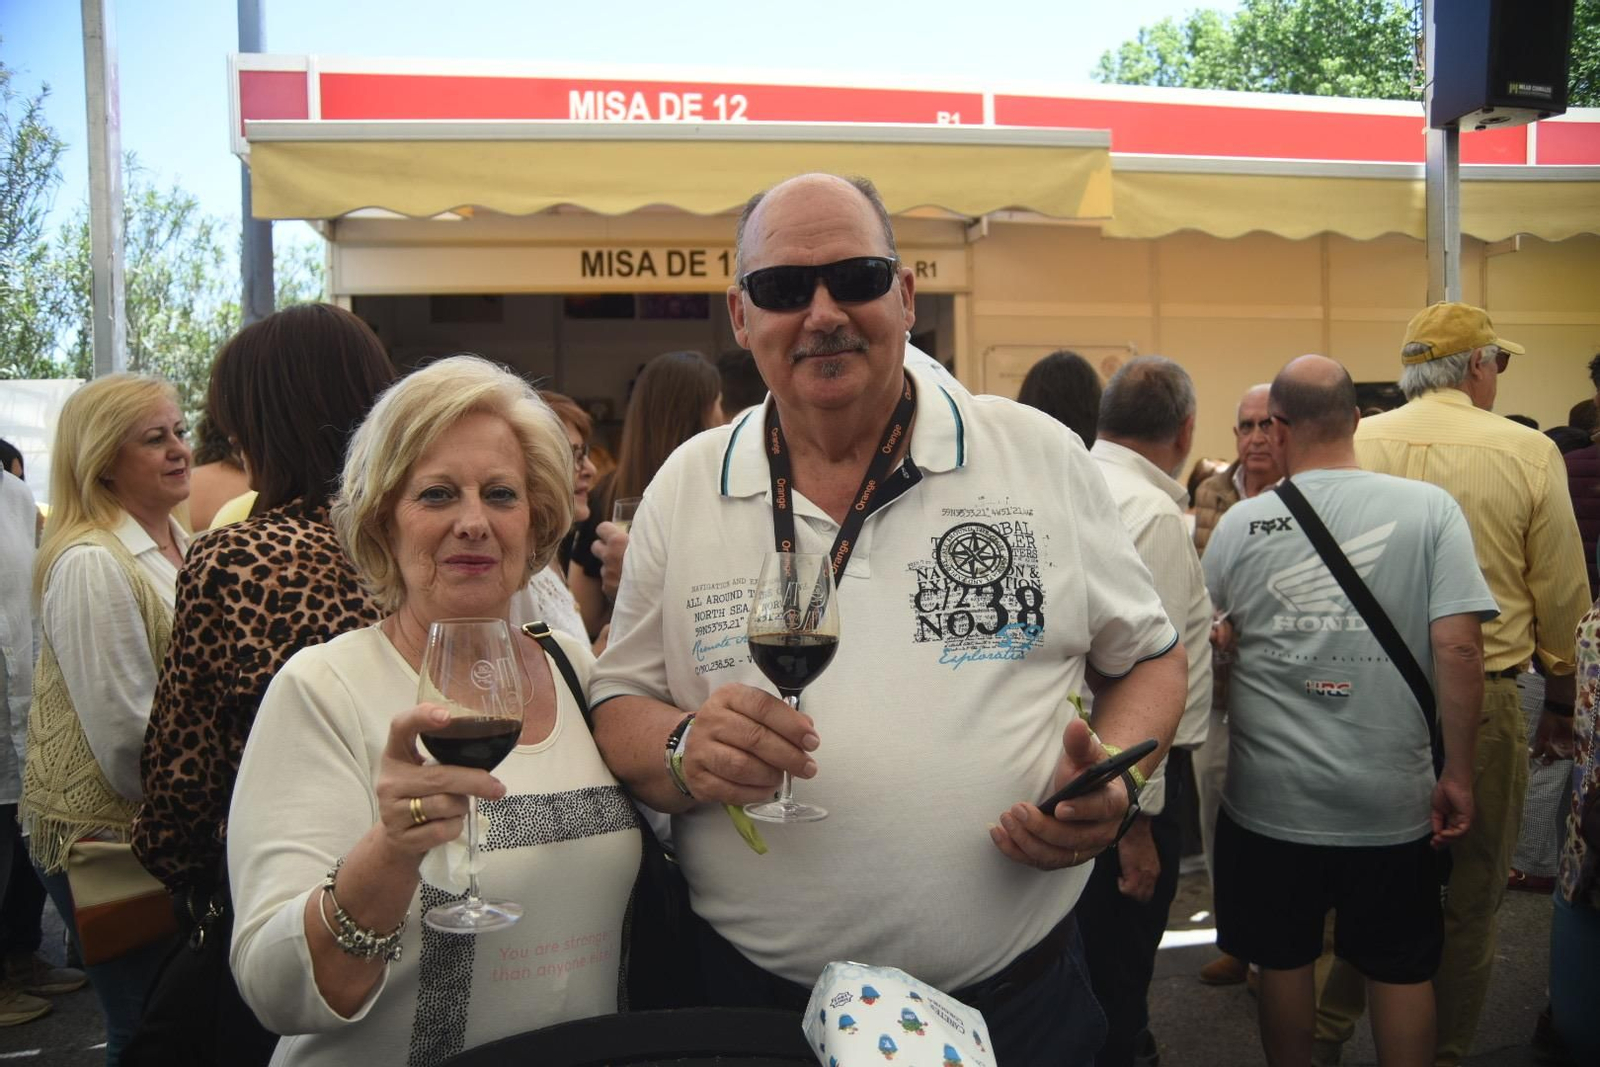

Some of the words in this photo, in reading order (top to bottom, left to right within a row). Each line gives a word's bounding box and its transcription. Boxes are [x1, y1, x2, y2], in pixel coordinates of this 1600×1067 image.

[568, 90, 651, 121] MISA
[659, 92, 703, 122] DE
[713, 94, 749, 121] 12
[581, 249, 657, 277] MISA
[668, 249, 707, 277] DE
[916, 261, 937, 277] R1
[881, 423, 902, 454] Orange
[776, 477, 787, 509] Orange
[855, 479, 877, 511] Orange
[732, 577, 746, 586] AND
[686, 597, 702, 609] ALL
[706, 589, 743, 605] AROUND
[694, 608, 725, 622] NORTH
[1272, 615, 1370, 632] HOND
[500, 947, 528, 960] You
[535, 942, 560, 956] are
[491, 967, 530, 980] than
[536, 955, 587, 979] anyone
